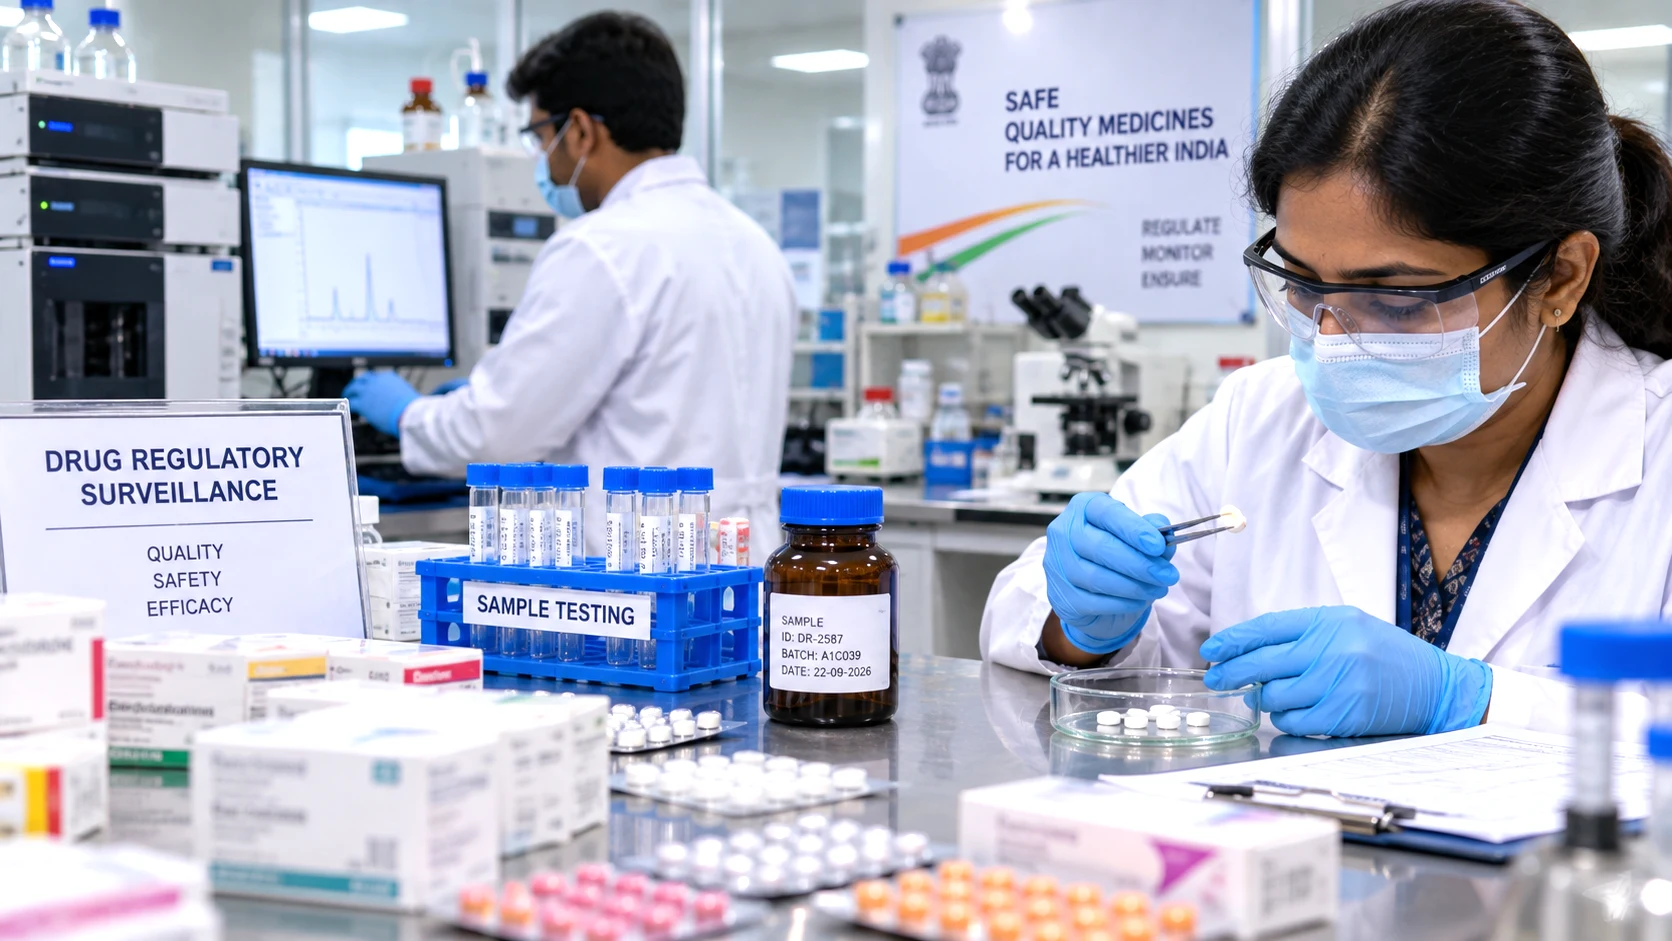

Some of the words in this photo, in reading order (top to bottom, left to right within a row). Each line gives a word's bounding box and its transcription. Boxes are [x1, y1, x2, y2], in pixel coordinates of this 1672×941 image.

[1005, 87, 1059, 113] SAFE
[1004, 116, 1093, 144] QUALITY
[1098, 106, 1214, 136] MEDICINES
[1005, 150, 1043, 172] FOR
[1047, 149, 1061, 170] A
[1066, 142, 1169, 168] HEALTHIER
[1175, 138, 1229, 161] INDIA
[1142, 216, 1221, 237] REGULATE
[1141, 243, 1213, 262] MONITOR
[1141, 269, 1201, 289] ENSURE
[45, 448, 122, 473] DRUG
[131, 446, 304, 471] REGULATORY
[81, 479, 278, 506] SURVEILLANCE
[147, 543, 223, 563] QUALITY
[153, 570, 222, 589] SAFETY
[147, 596, 233, 617] EFFICACY
[477, 594, 550, 619] SAMPLE
[555, 600, 635, 626] TESTING
[781, 615, 824, 628] SAMPLE
[781, 631, 795, 642] ID:
[797, 632, 844, 645] DR-2587
[781, 647, 818, 661] BATCH:
[821, 650, 862, 661] A1C039
[781, 664, 810, 677] DATE:
[813, 665, 872, 678] 22-09-2026
